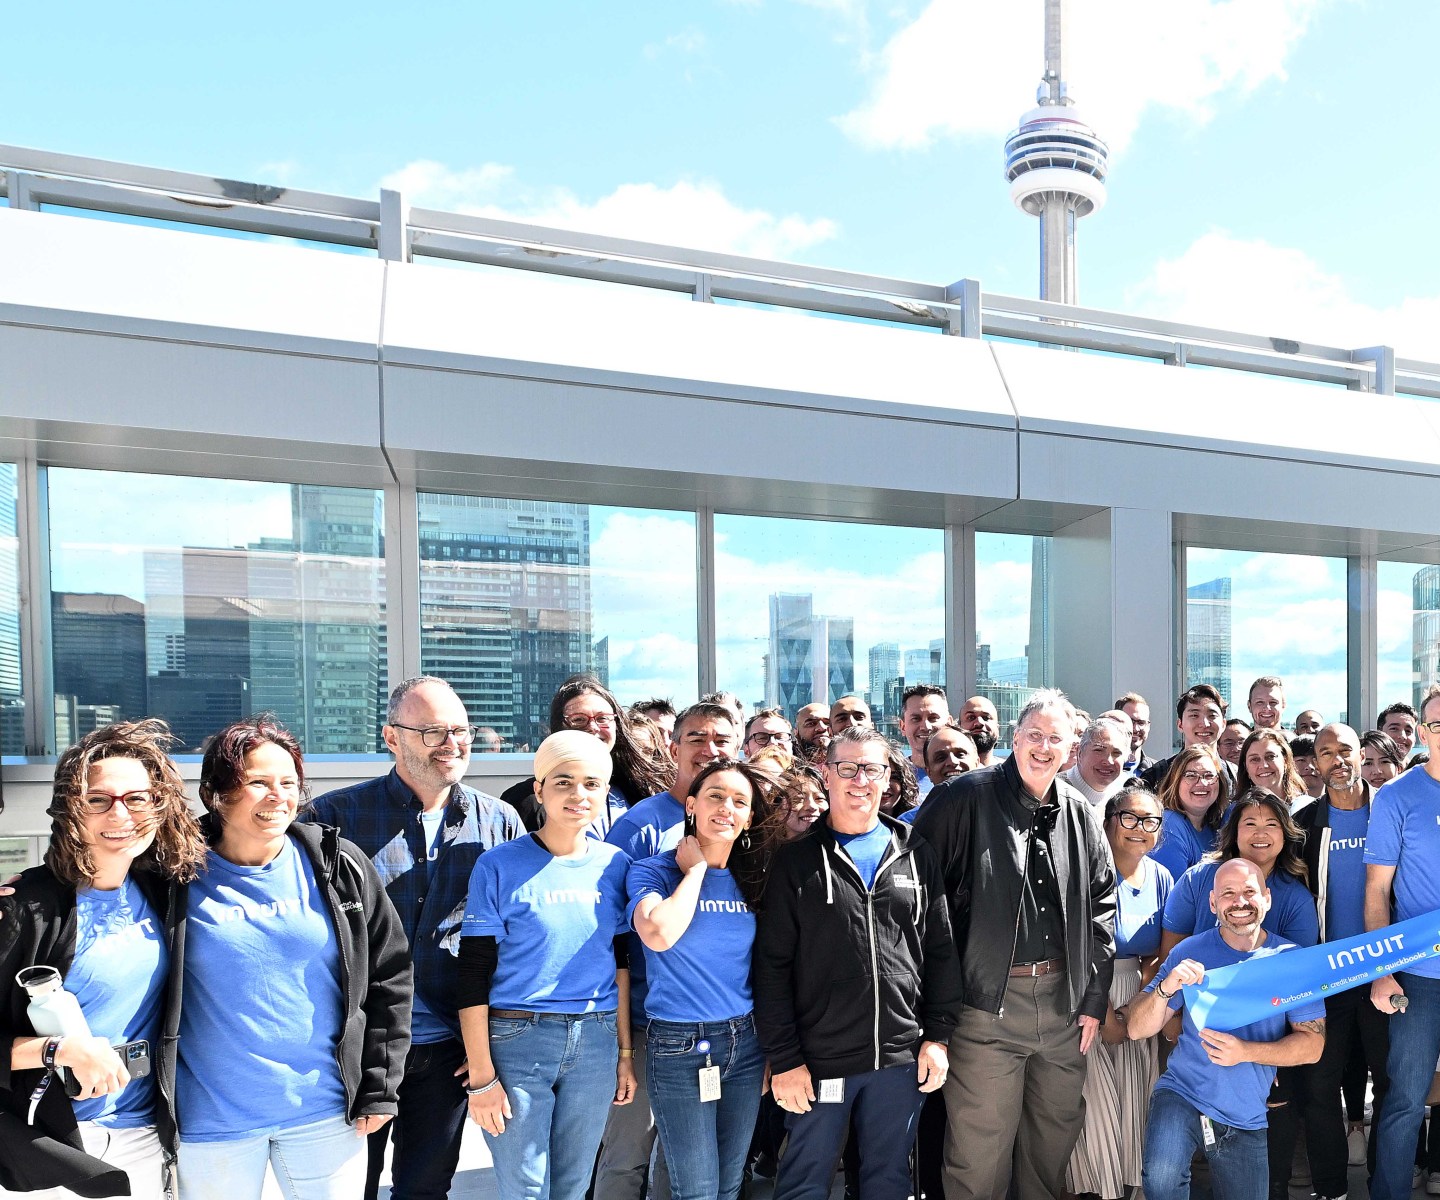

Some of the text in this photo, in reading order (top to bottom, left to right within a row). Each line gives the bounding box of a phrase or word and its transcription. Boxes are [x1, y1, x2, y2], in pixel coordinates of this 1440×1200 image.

[1330, 837, 1367, 851] NTUI
[700, 900, 748, 913] INTUIT
[1327, 933, 1404, 970] INTUIT
[1280, 990, 1313, 1004] turbotax
[1330, 977, 1348, 989] credit
[1347, 971, 1369, 983] karma
[1384, 951, 1427, 971] quickbooks
